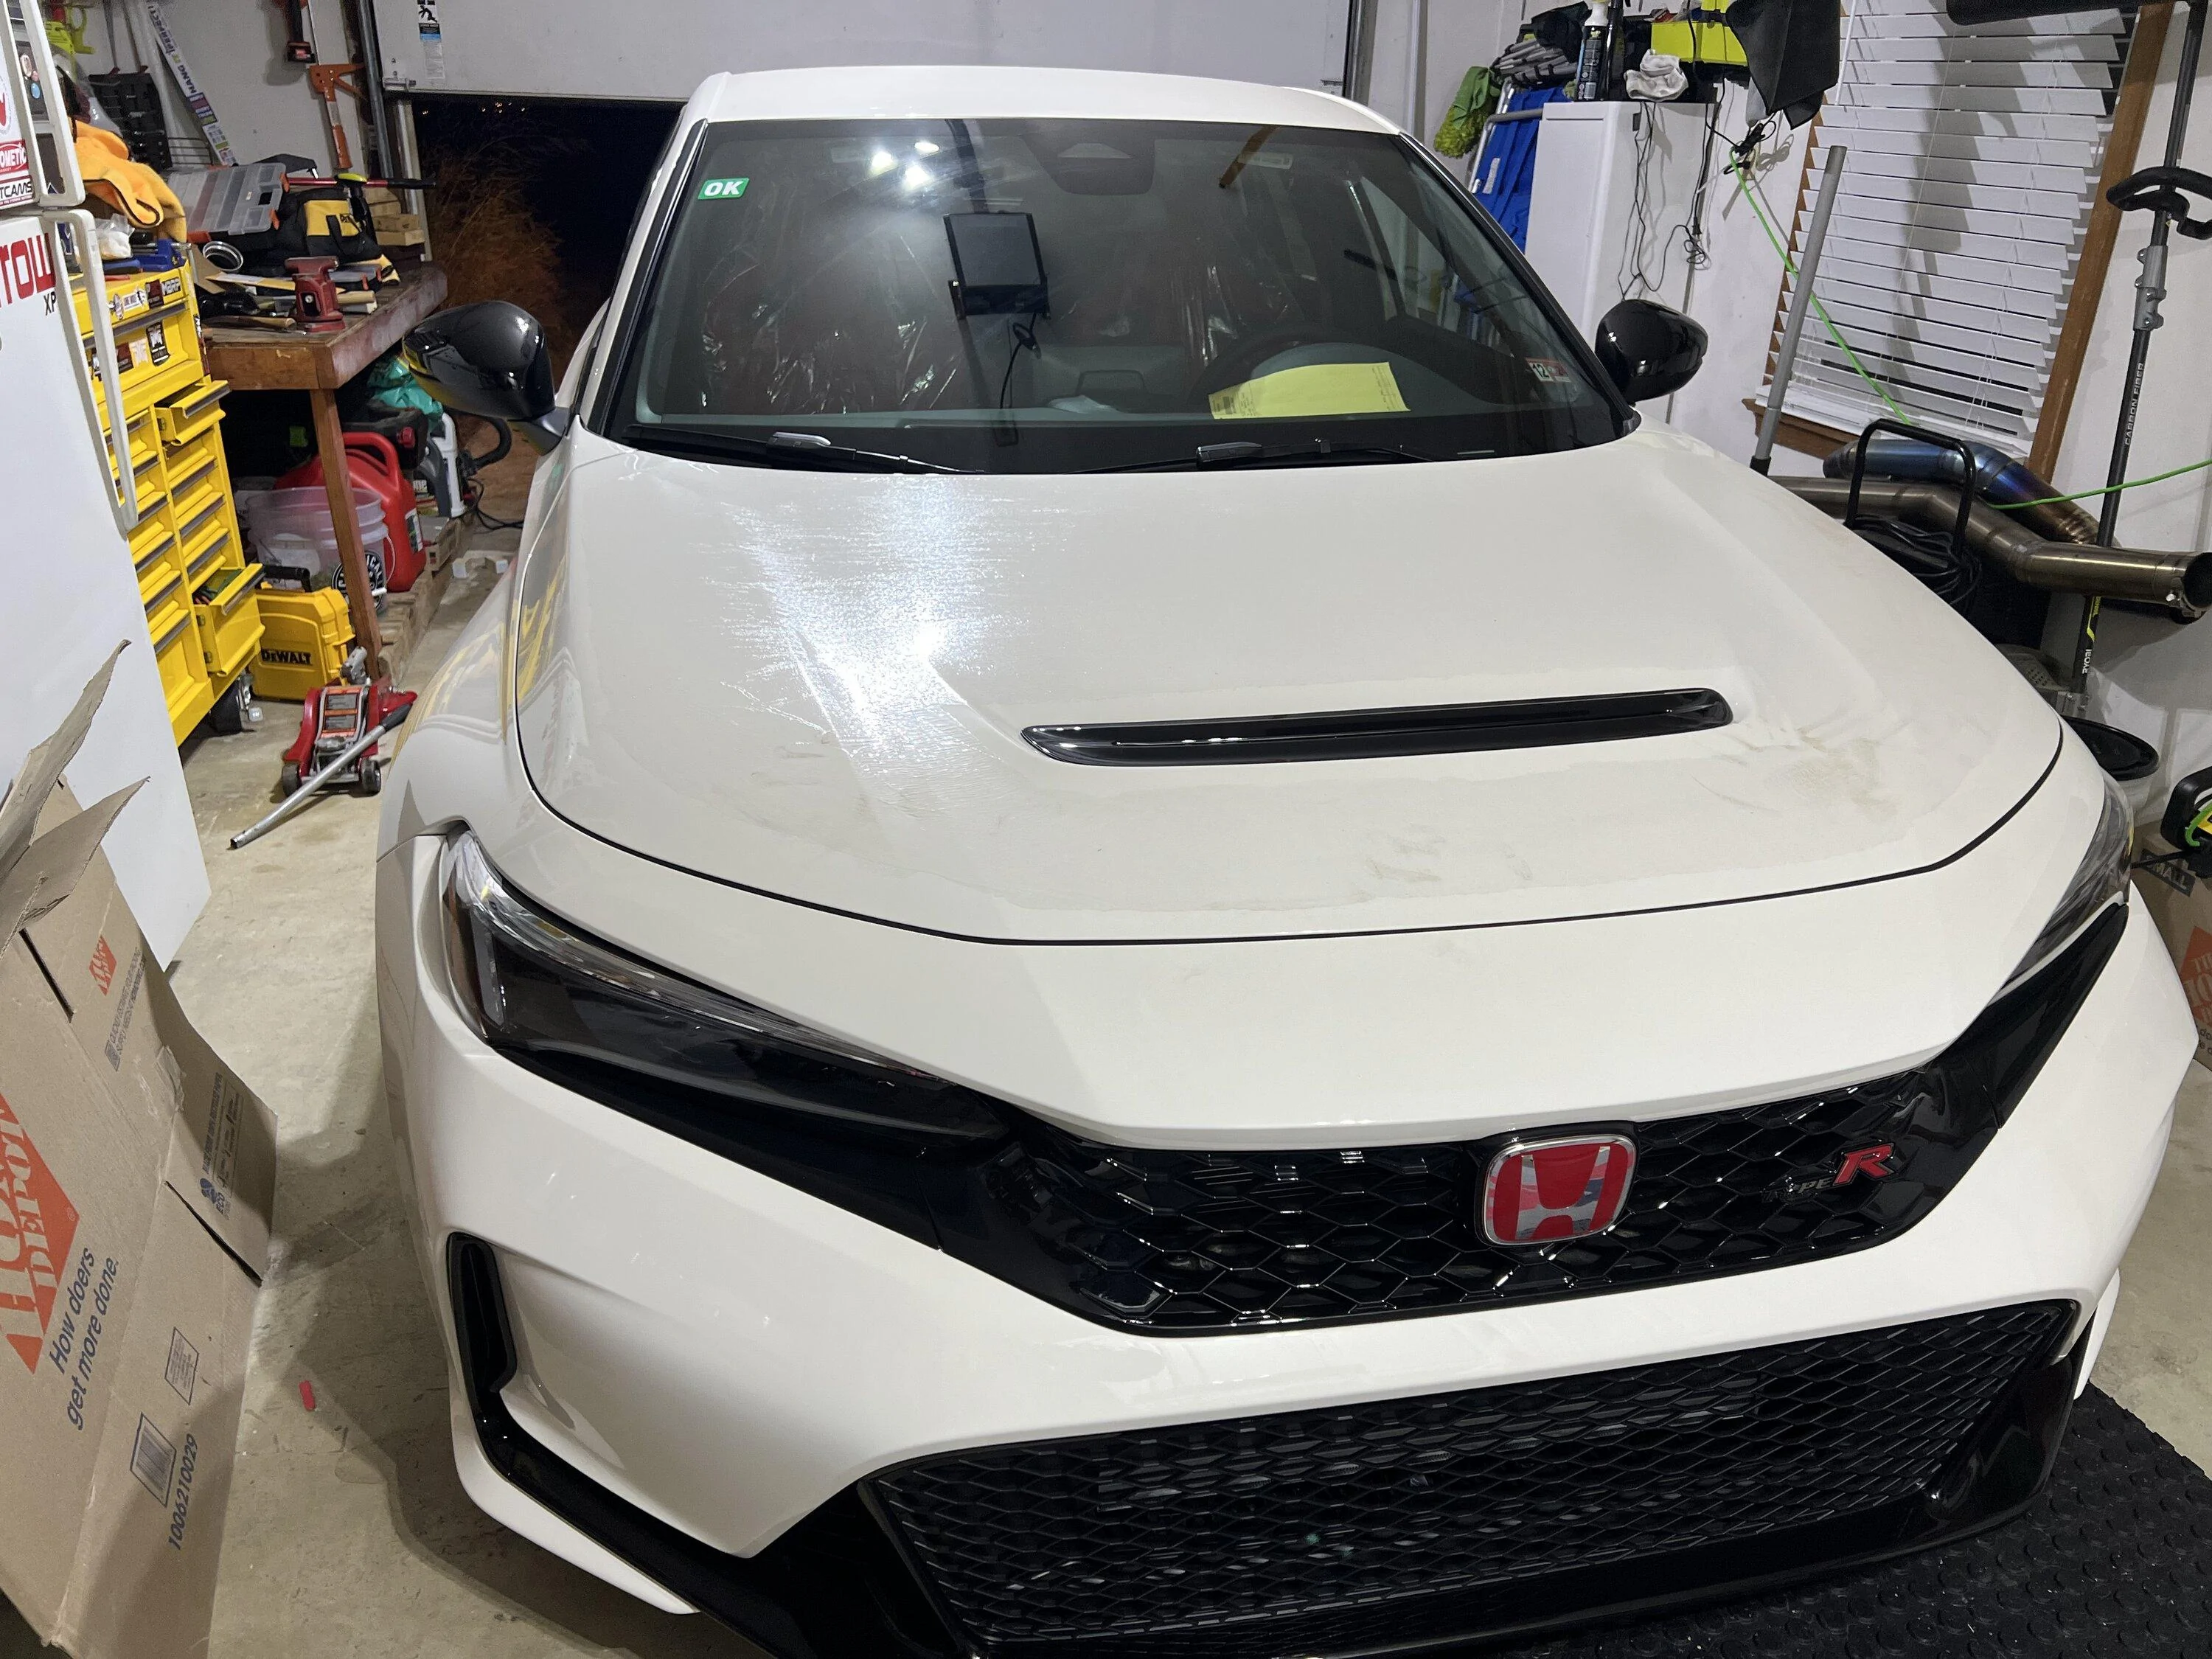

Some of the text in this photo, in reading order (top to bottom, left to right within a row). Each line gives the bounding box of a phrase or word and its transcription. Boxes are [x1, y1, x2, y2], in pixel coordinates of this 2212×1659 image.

[704, 181, 744, 197] OK
[44, 291, 57, 316] XP
[2124, 399, 2138, 446] CARBON
[2081, 649, 2093, 675] RYOBI
[49, 1248, 95, 1375] How doers
[67, 1256, 119, 1430] get more done.
[168, 1433, 198, 1551] 1006210029
